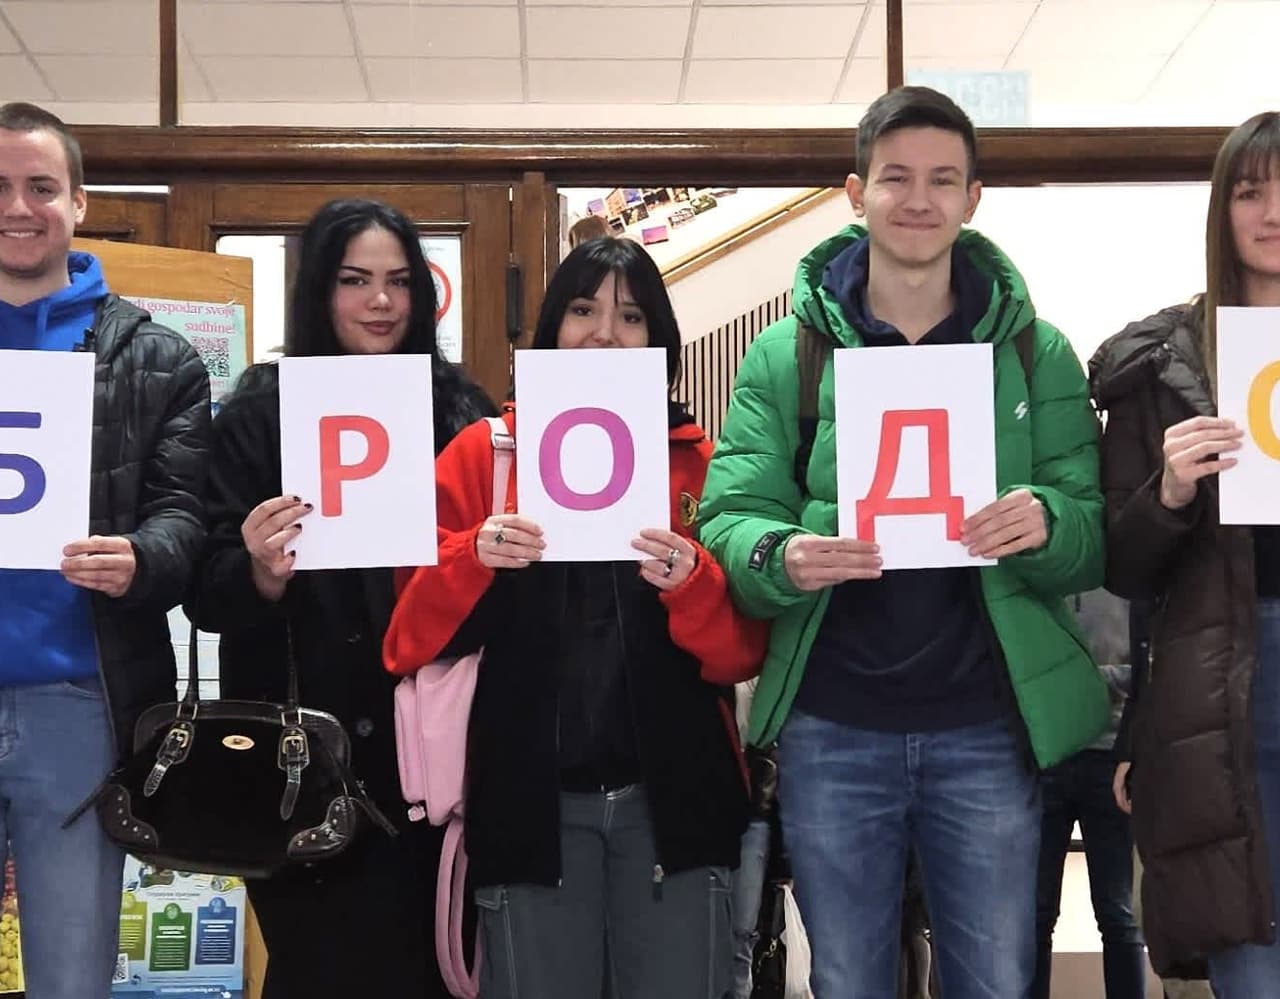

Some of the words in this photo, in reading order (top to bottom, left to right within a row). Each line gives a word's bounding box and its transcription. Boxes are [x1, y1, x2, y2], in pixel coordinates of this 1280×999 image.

[319, 415, 390, 518] Р
[538, 406, 635, 511] О
[856, 408, 965, 542] Д
